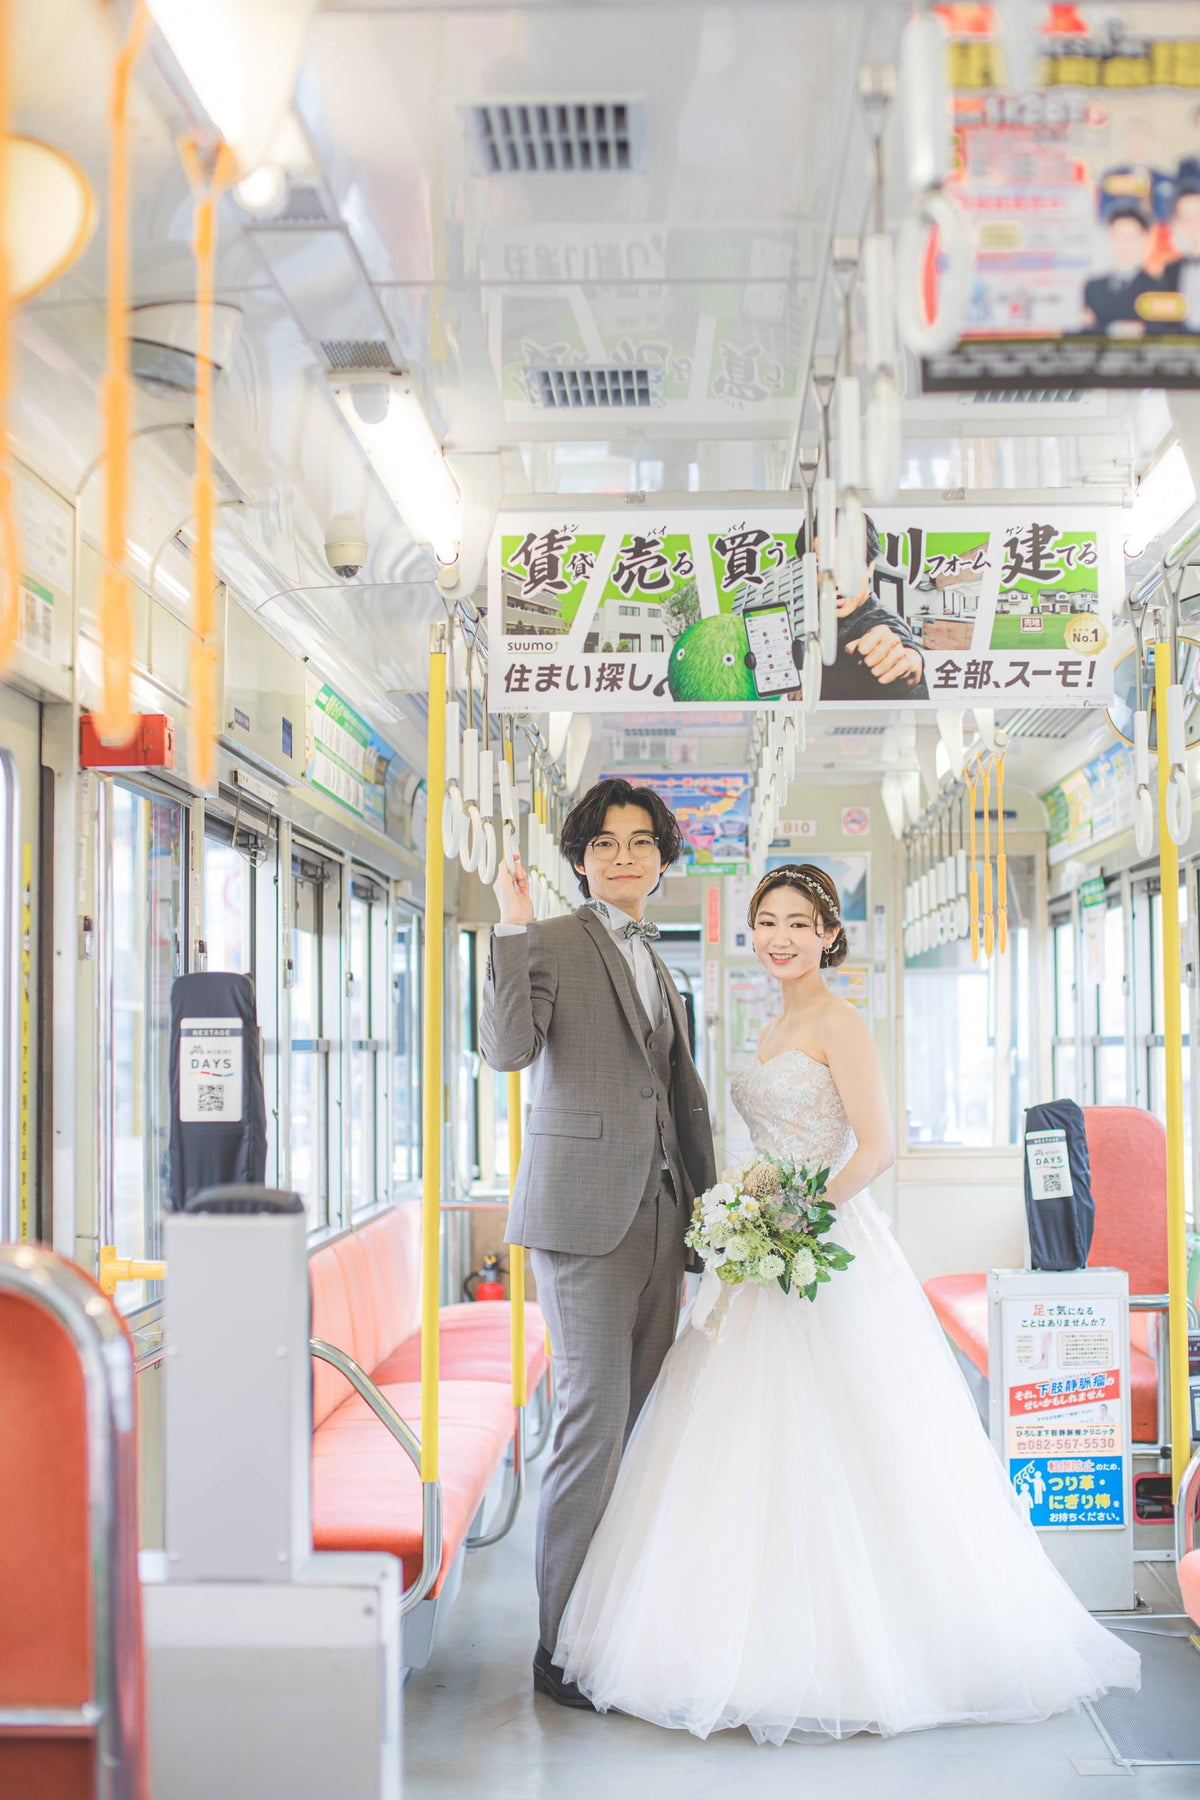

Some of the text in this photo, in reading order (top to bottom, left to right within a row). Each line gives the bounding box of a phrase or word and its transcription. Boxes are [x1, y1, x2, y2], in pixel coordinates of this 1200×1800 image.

[714, 529, 785, 589] 買う
[886, 526, 993, 586] リフォーム
[1001, 522, 1098, 585] 建てる
[612, 535, 694, 594] 売る
[1072, 628, 1099, 644] No.1
[507, 640, 554, 652] suumo
[191, 1058, 232, 1070] DAYS
[1036, 1156, 1063, 1165] DAYS
[1033, 1304, 1094, 1316] 足で気になる
[1028, 1438, 1116, 1450] 082-567-5530
